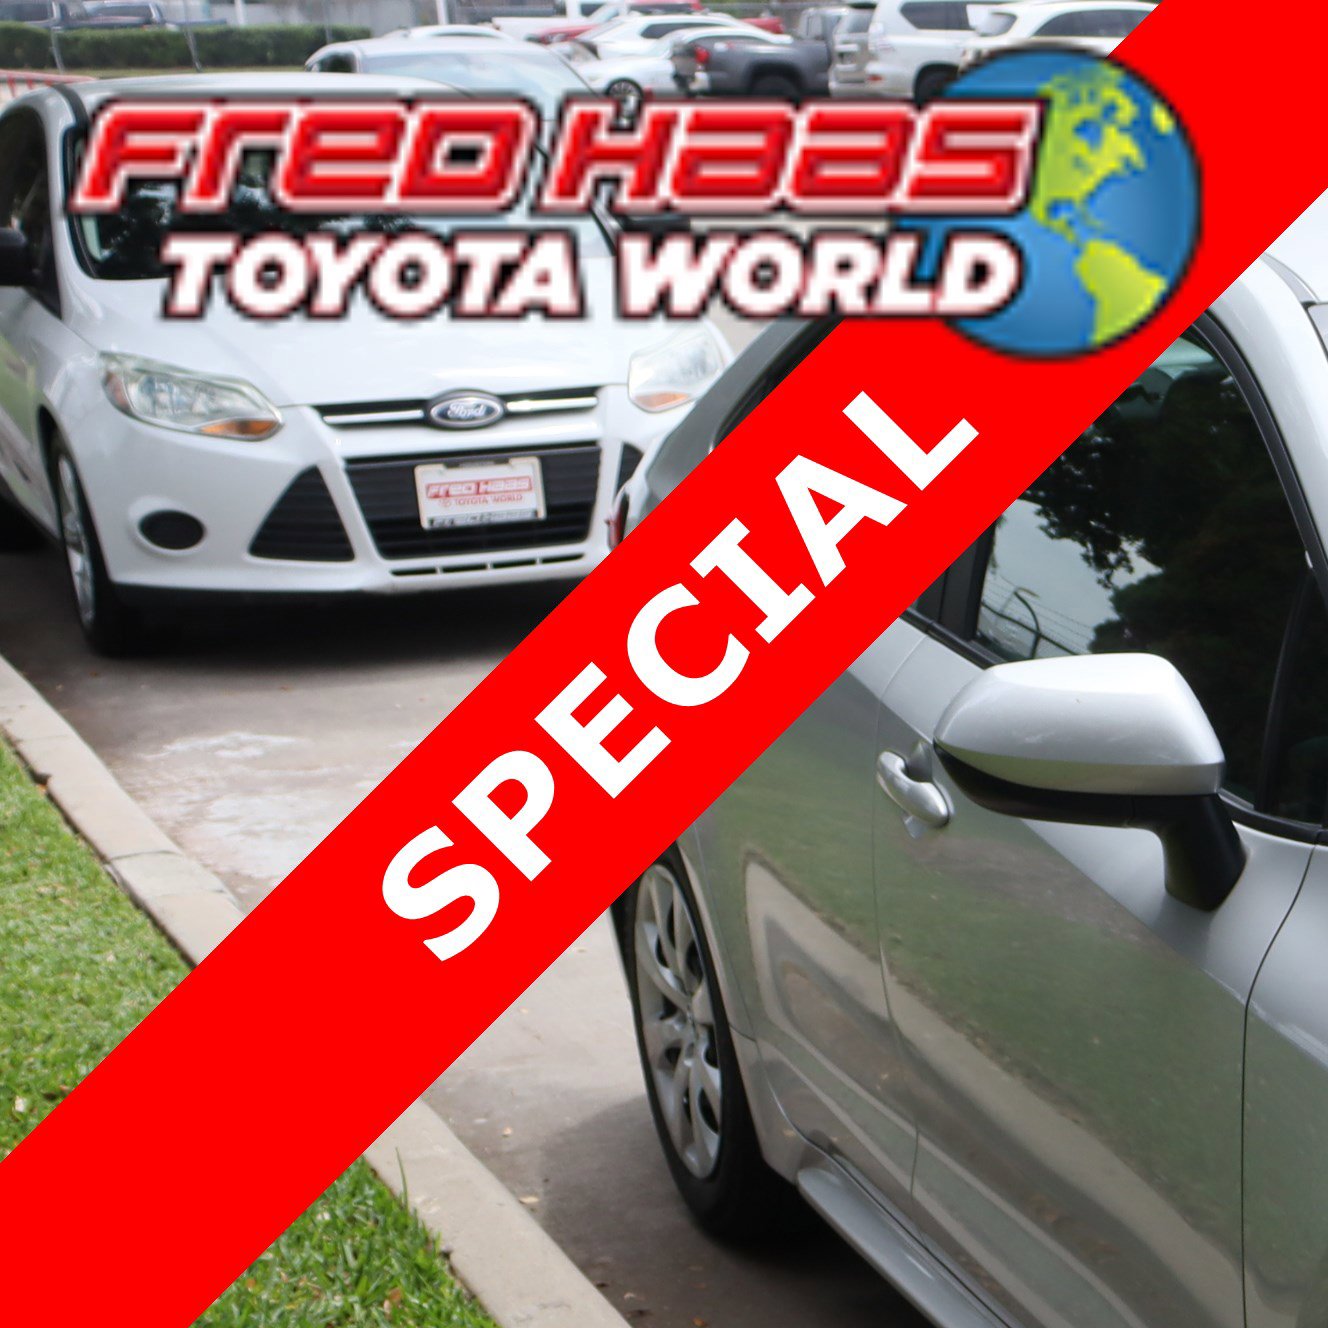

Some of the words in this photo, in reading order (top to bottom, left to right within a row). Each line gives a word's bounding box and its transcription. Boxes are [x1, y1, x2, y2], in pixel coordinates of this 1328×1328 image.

[447, 403, 487, 419] Ford
[455, 496, 489, 507] TOYOTA
[491, 493, 523, 505] WORLD
